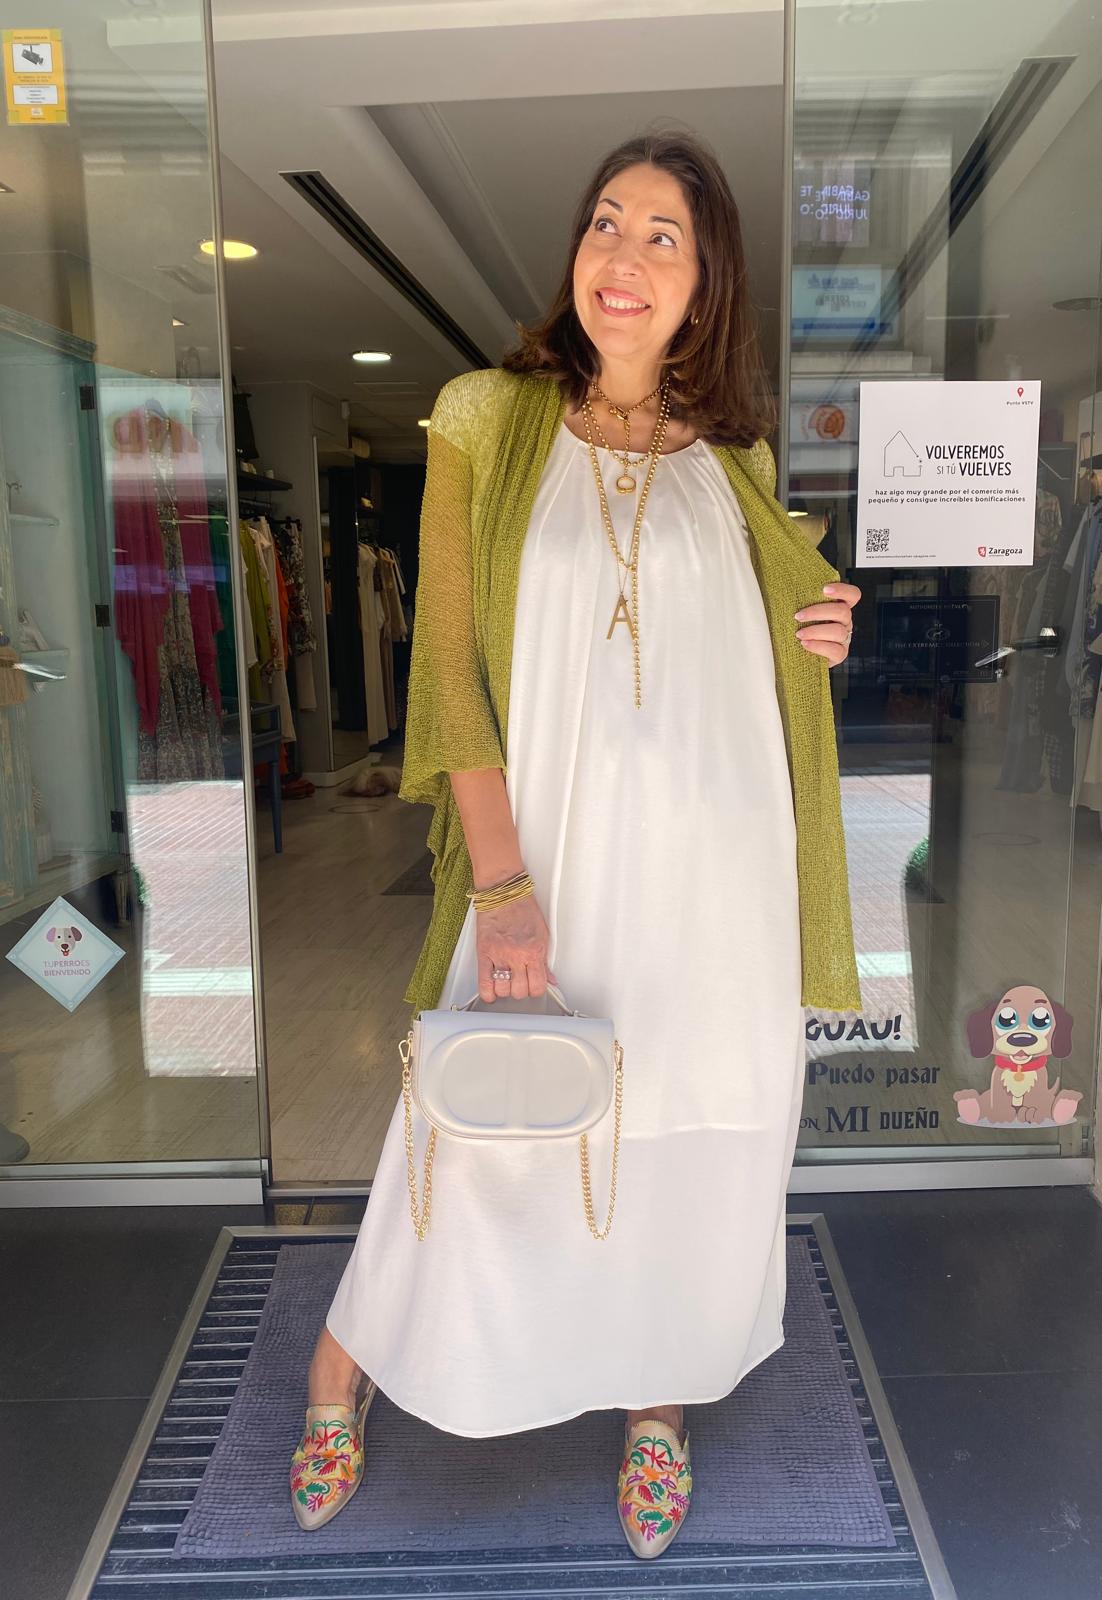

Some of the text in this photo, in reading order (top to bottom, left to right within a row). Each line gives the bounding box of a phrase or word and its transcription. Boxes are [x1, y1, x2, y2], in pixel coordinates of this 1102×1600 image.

[925, 444, 1005, 460] VOLVEREMOS
[936, 461, 1012, 477] SI TÚ VUELVES
[868, 496, 899, 505] pequeño
[906, 496, 939, 504] consigue
[975, 495, 1026, 503] bonificaciones
[889, 489, 905, 497] algo
[922, 489, 948, 497] grande
[970, 487, 1004, 496] comercio
[1004, 487, 1020, 495] más
[988, 546, 1023, 557] Zaragoza
[43, 968, 91, 977] BIENVENIDO
[805, 1014, 902, 1041] GUAU!
[808, 1062, 941, 1088] Puedo pasar
[799, 1106, 939, 1133] ON MI DUEÑO
